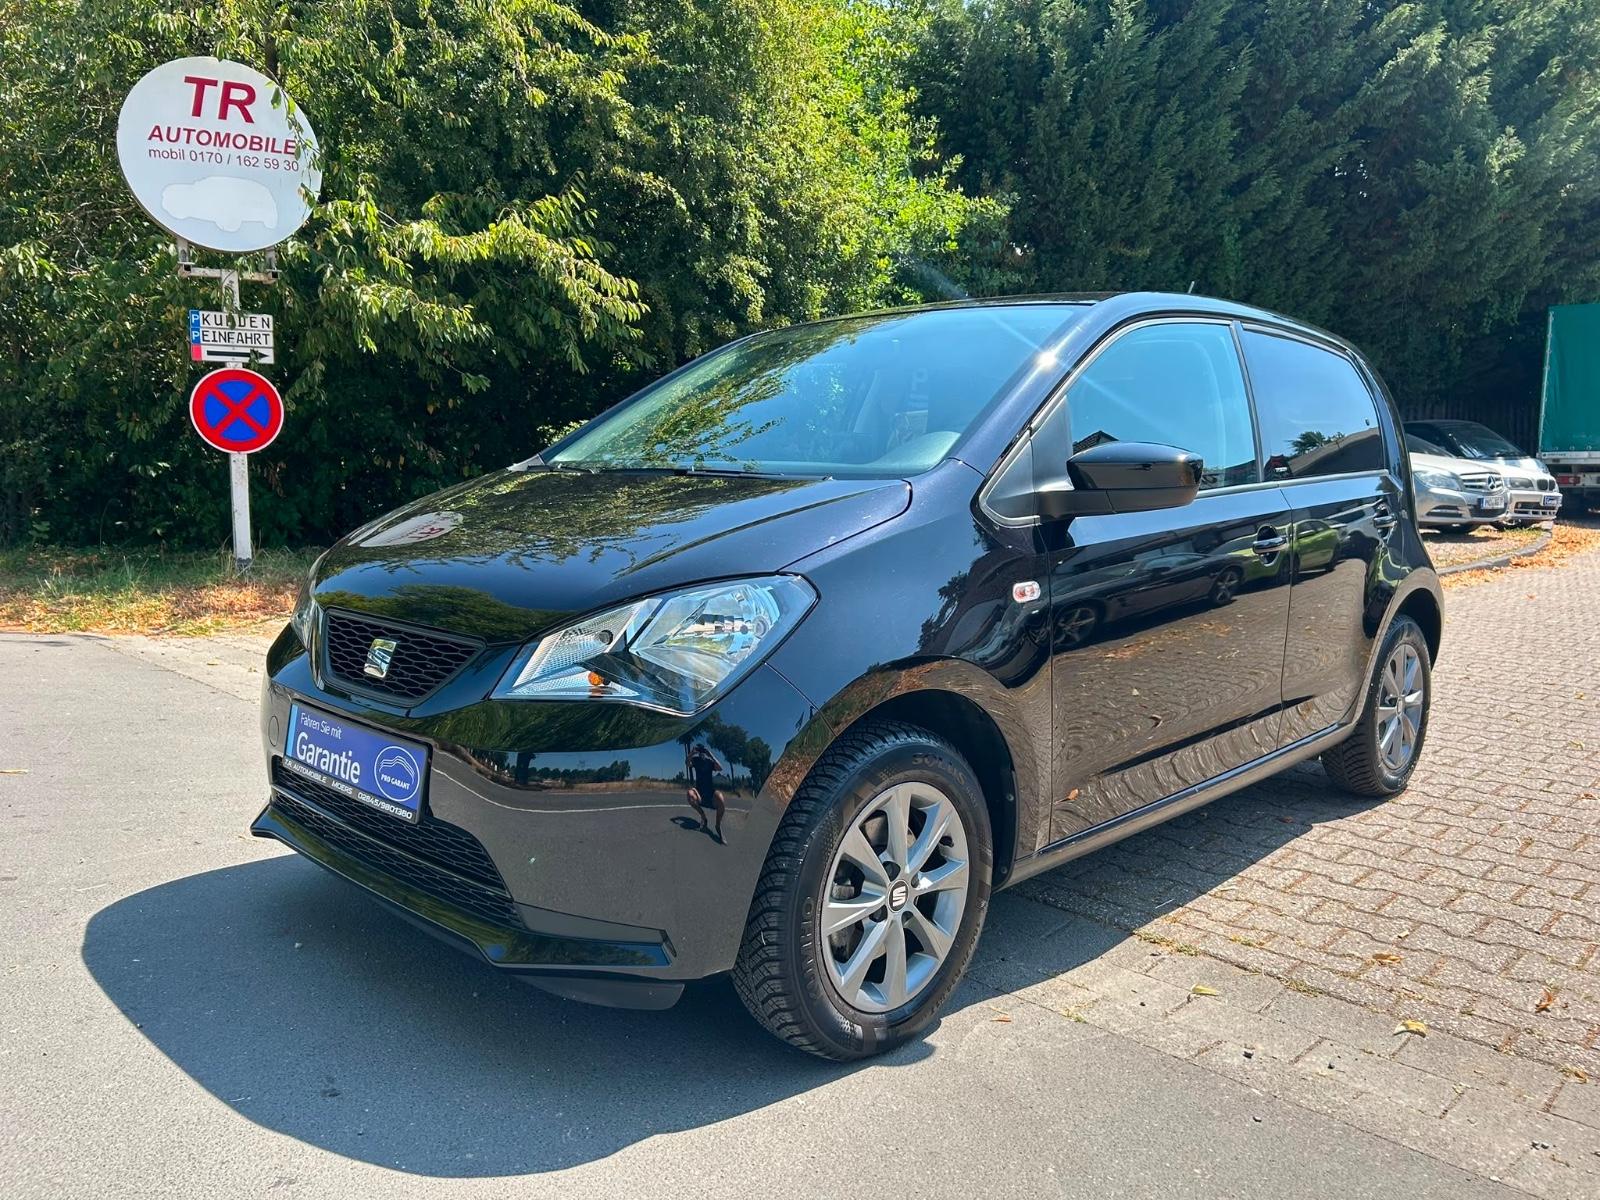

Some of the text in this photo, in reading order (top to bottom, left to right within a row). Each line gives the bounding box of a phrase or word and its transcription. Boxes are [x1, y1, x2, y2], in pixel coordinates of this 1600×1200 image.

[184, 76, 256, 124] TR
[148, 125, 297, 156] AUTOMOBILE
[148, 148, 185, 161] mobil
[190, 150, 223, 164] 0170
[236, 155, 259, 168] 162
[264, 159, 280, 170] 59
[283, 160, 299, 172] 30
[202, 330, 270, 345] EINFAHRT
[300, 712, 342, 740] Fahren Sie mit
[296, 731, 361, 784] Garantie
[293, 763, 328, 784] AUTOMOBILE
[331, 780, 353, 795] MOERS
